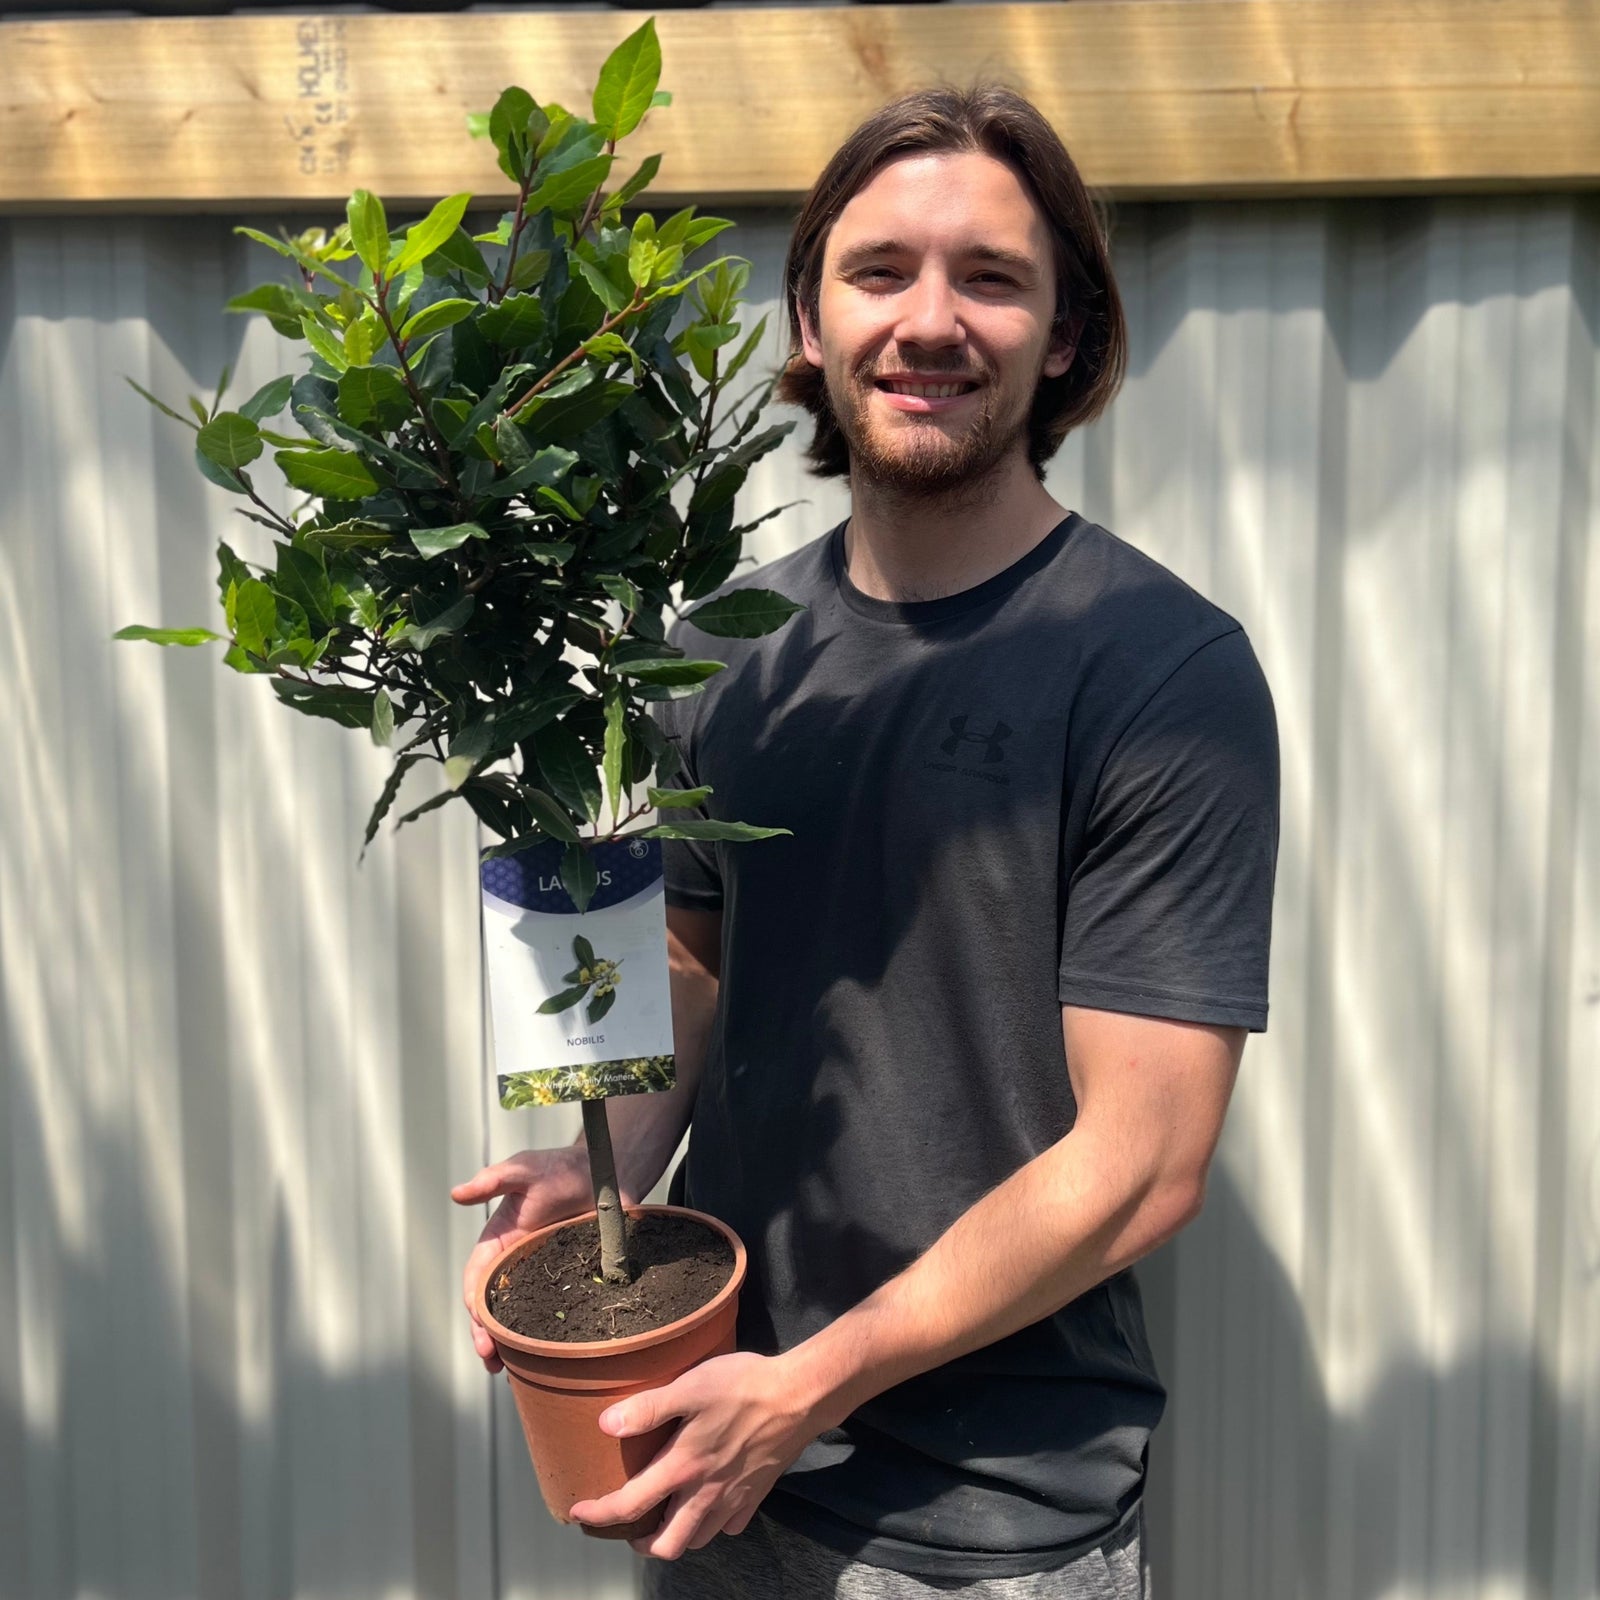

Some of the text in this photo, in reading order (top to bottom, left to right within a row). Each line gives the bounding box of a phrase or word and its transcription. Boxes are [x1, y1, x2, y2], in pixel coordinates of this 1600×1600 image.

[539, 870, 612, 891] LAS
[567, 1035, 605, 1046] NOBILIS
[604, 1073, 635, 1082] Matters
